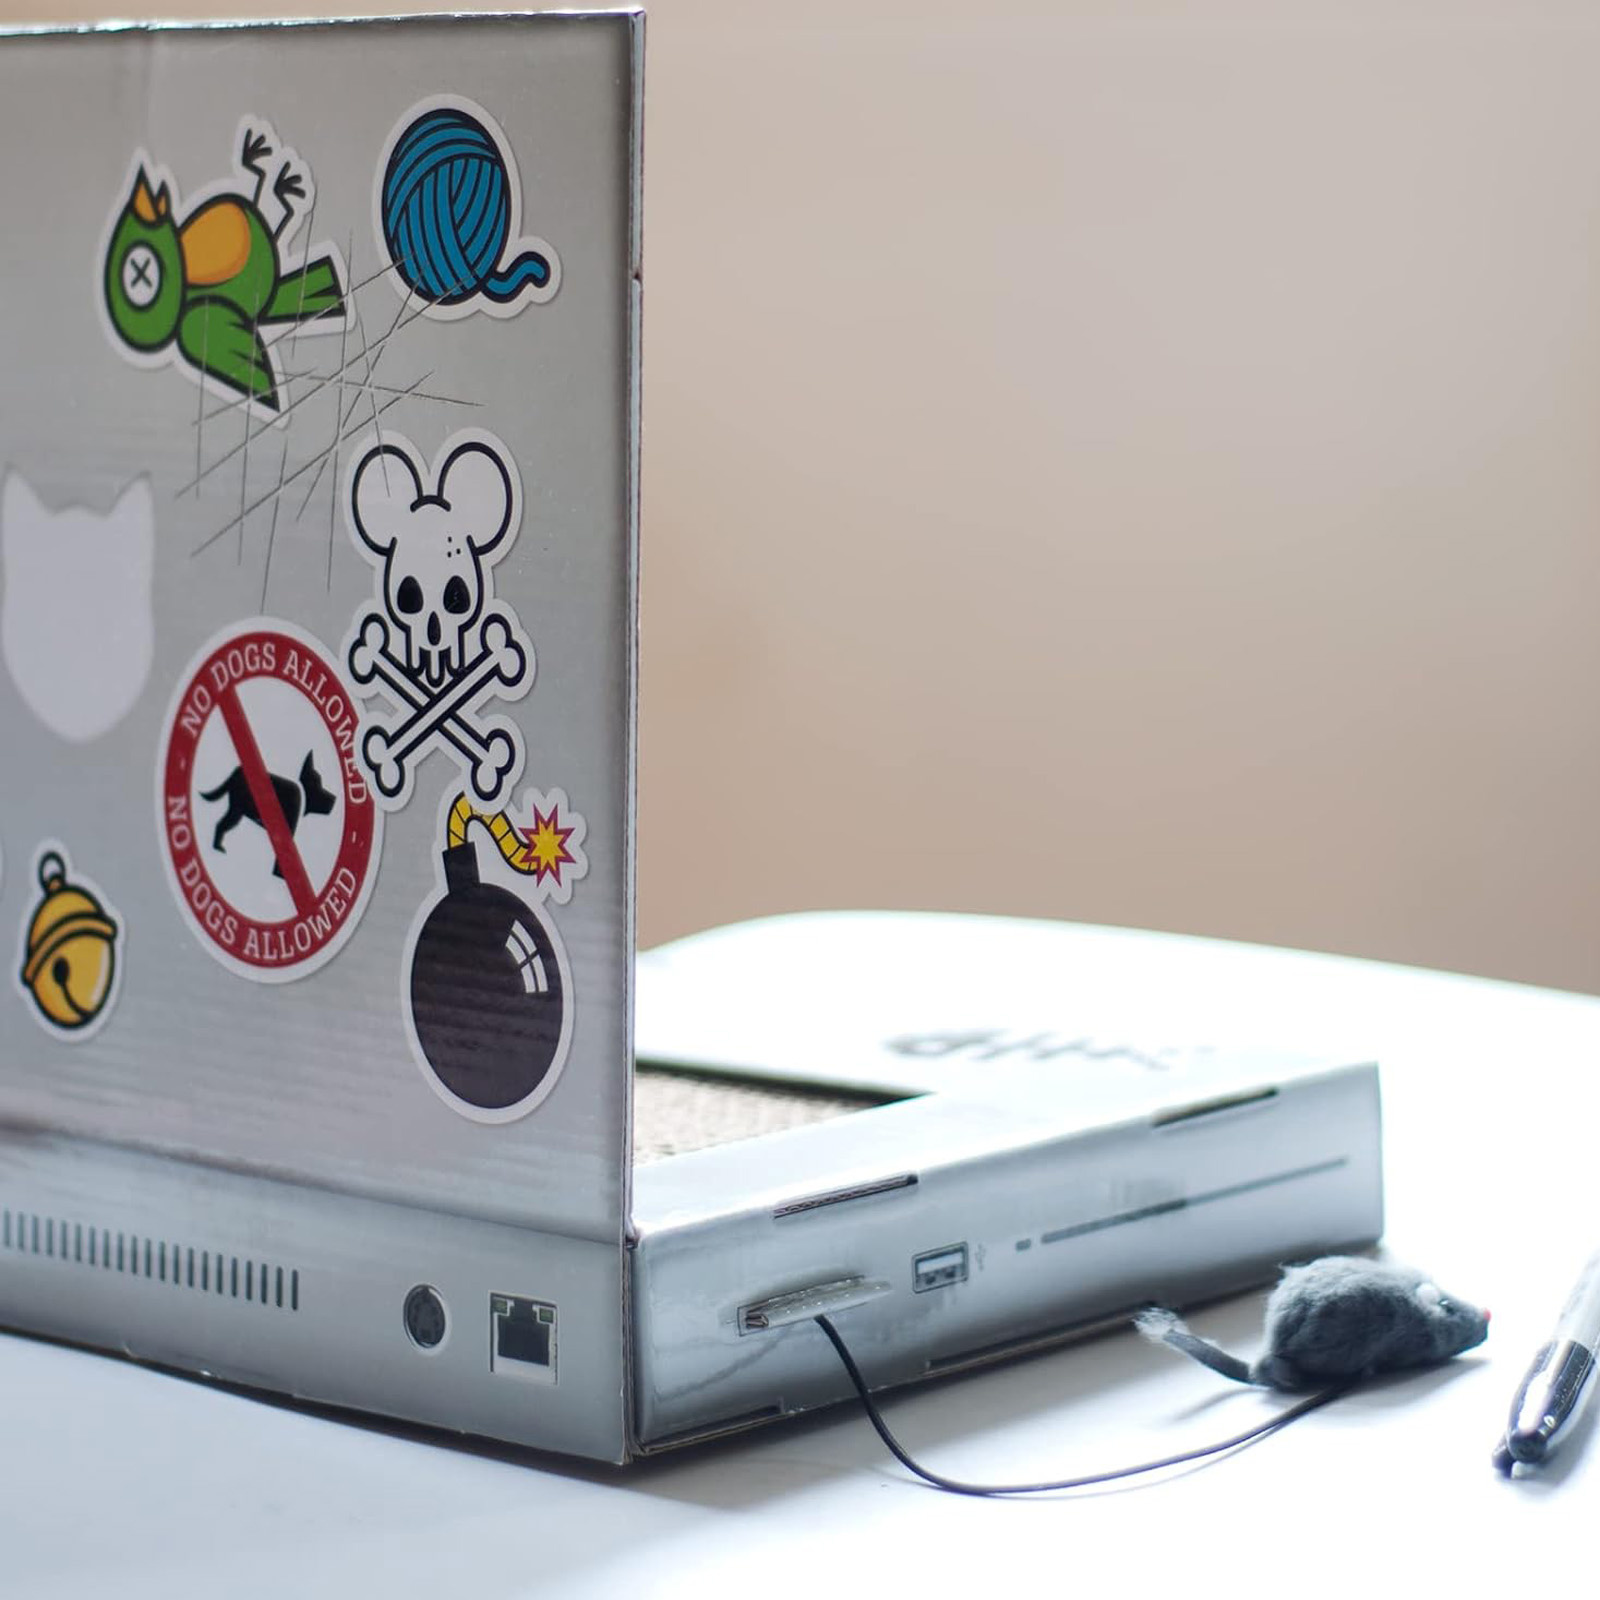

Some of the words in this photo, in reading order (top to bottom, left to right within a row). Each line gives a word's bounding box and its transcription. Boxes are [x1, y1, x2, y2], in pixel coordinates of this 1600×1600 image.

[182, 685, 212, 738] NO
[211, 643, 276, 692] DOGS
[169, 795, 191, 850] NO
[181, 859, 238, 945] DOGS
[244, 867, 357, 960] ALLOWED
